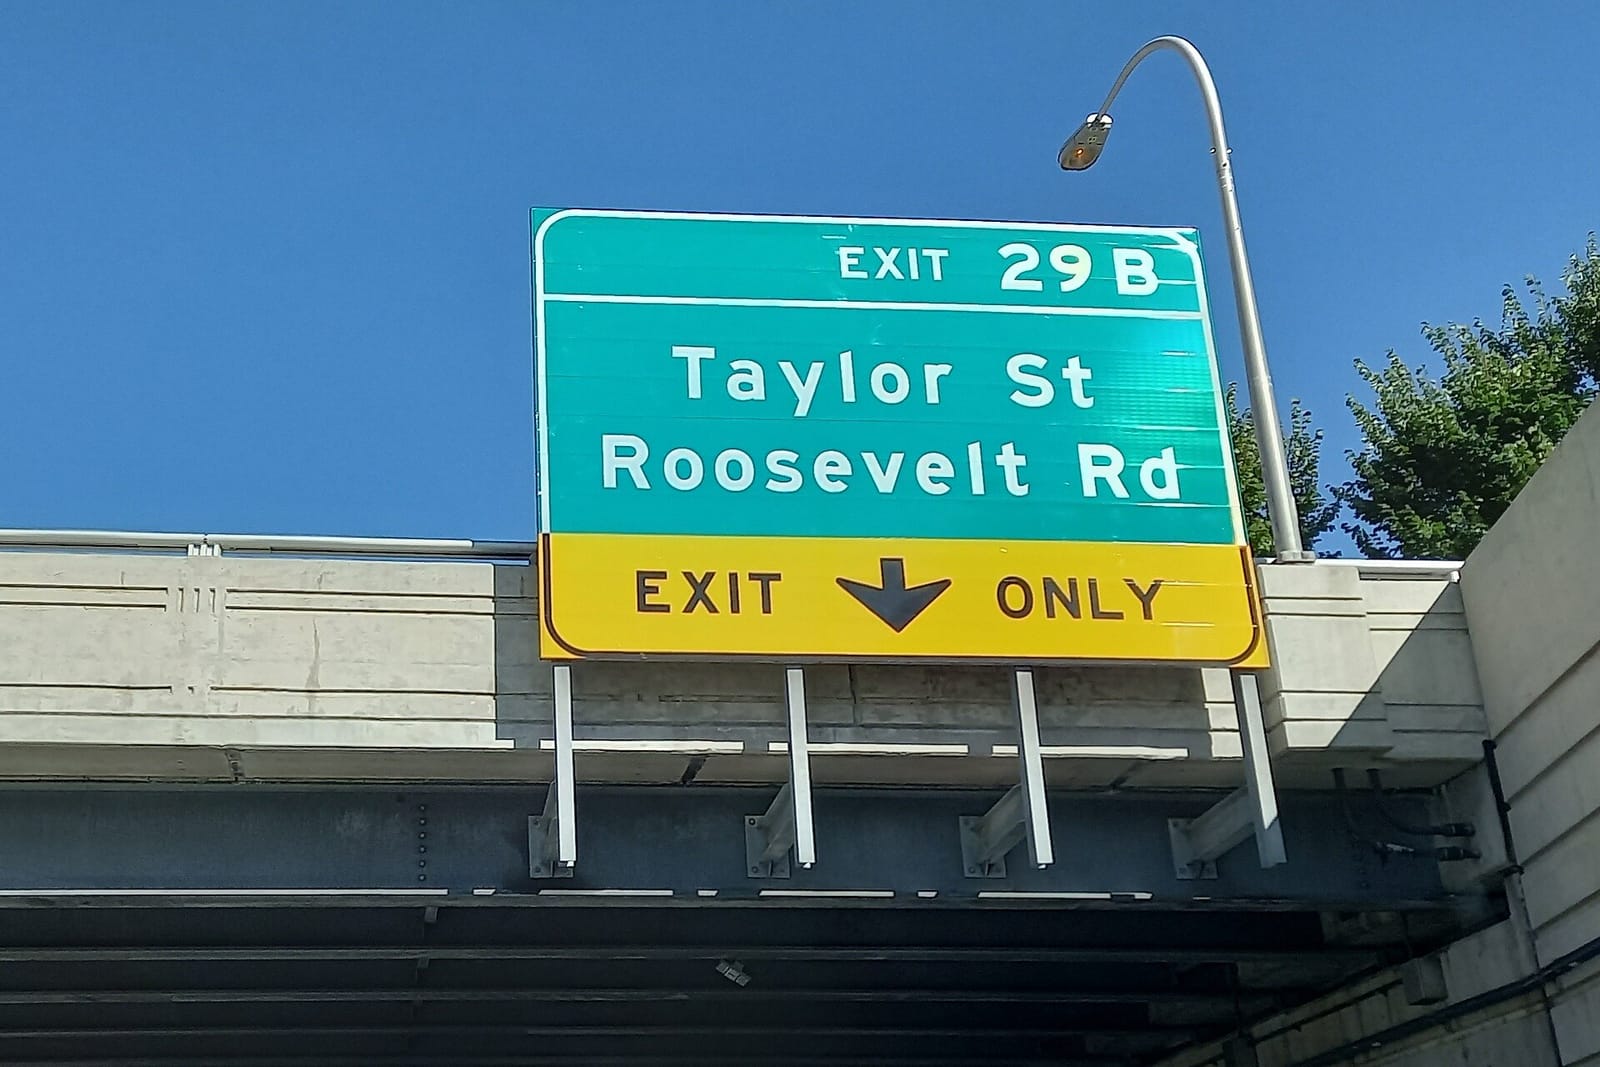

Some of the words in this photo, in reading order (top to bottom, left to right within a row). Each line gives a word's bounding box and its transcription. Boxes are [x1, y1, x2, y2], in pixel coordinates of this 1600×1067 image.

[840, 247, 949, 280] EXIT
[673, 347, 953, 417] Taylor
[1007, 354, 1094, 407] St
[603, 435, 1029, 495] Roosevelt
[1078, 444, 1182, 500] Rd
[637, 571, 782, 614] EXIT
[997, 576, 1165, 621] ONLY
